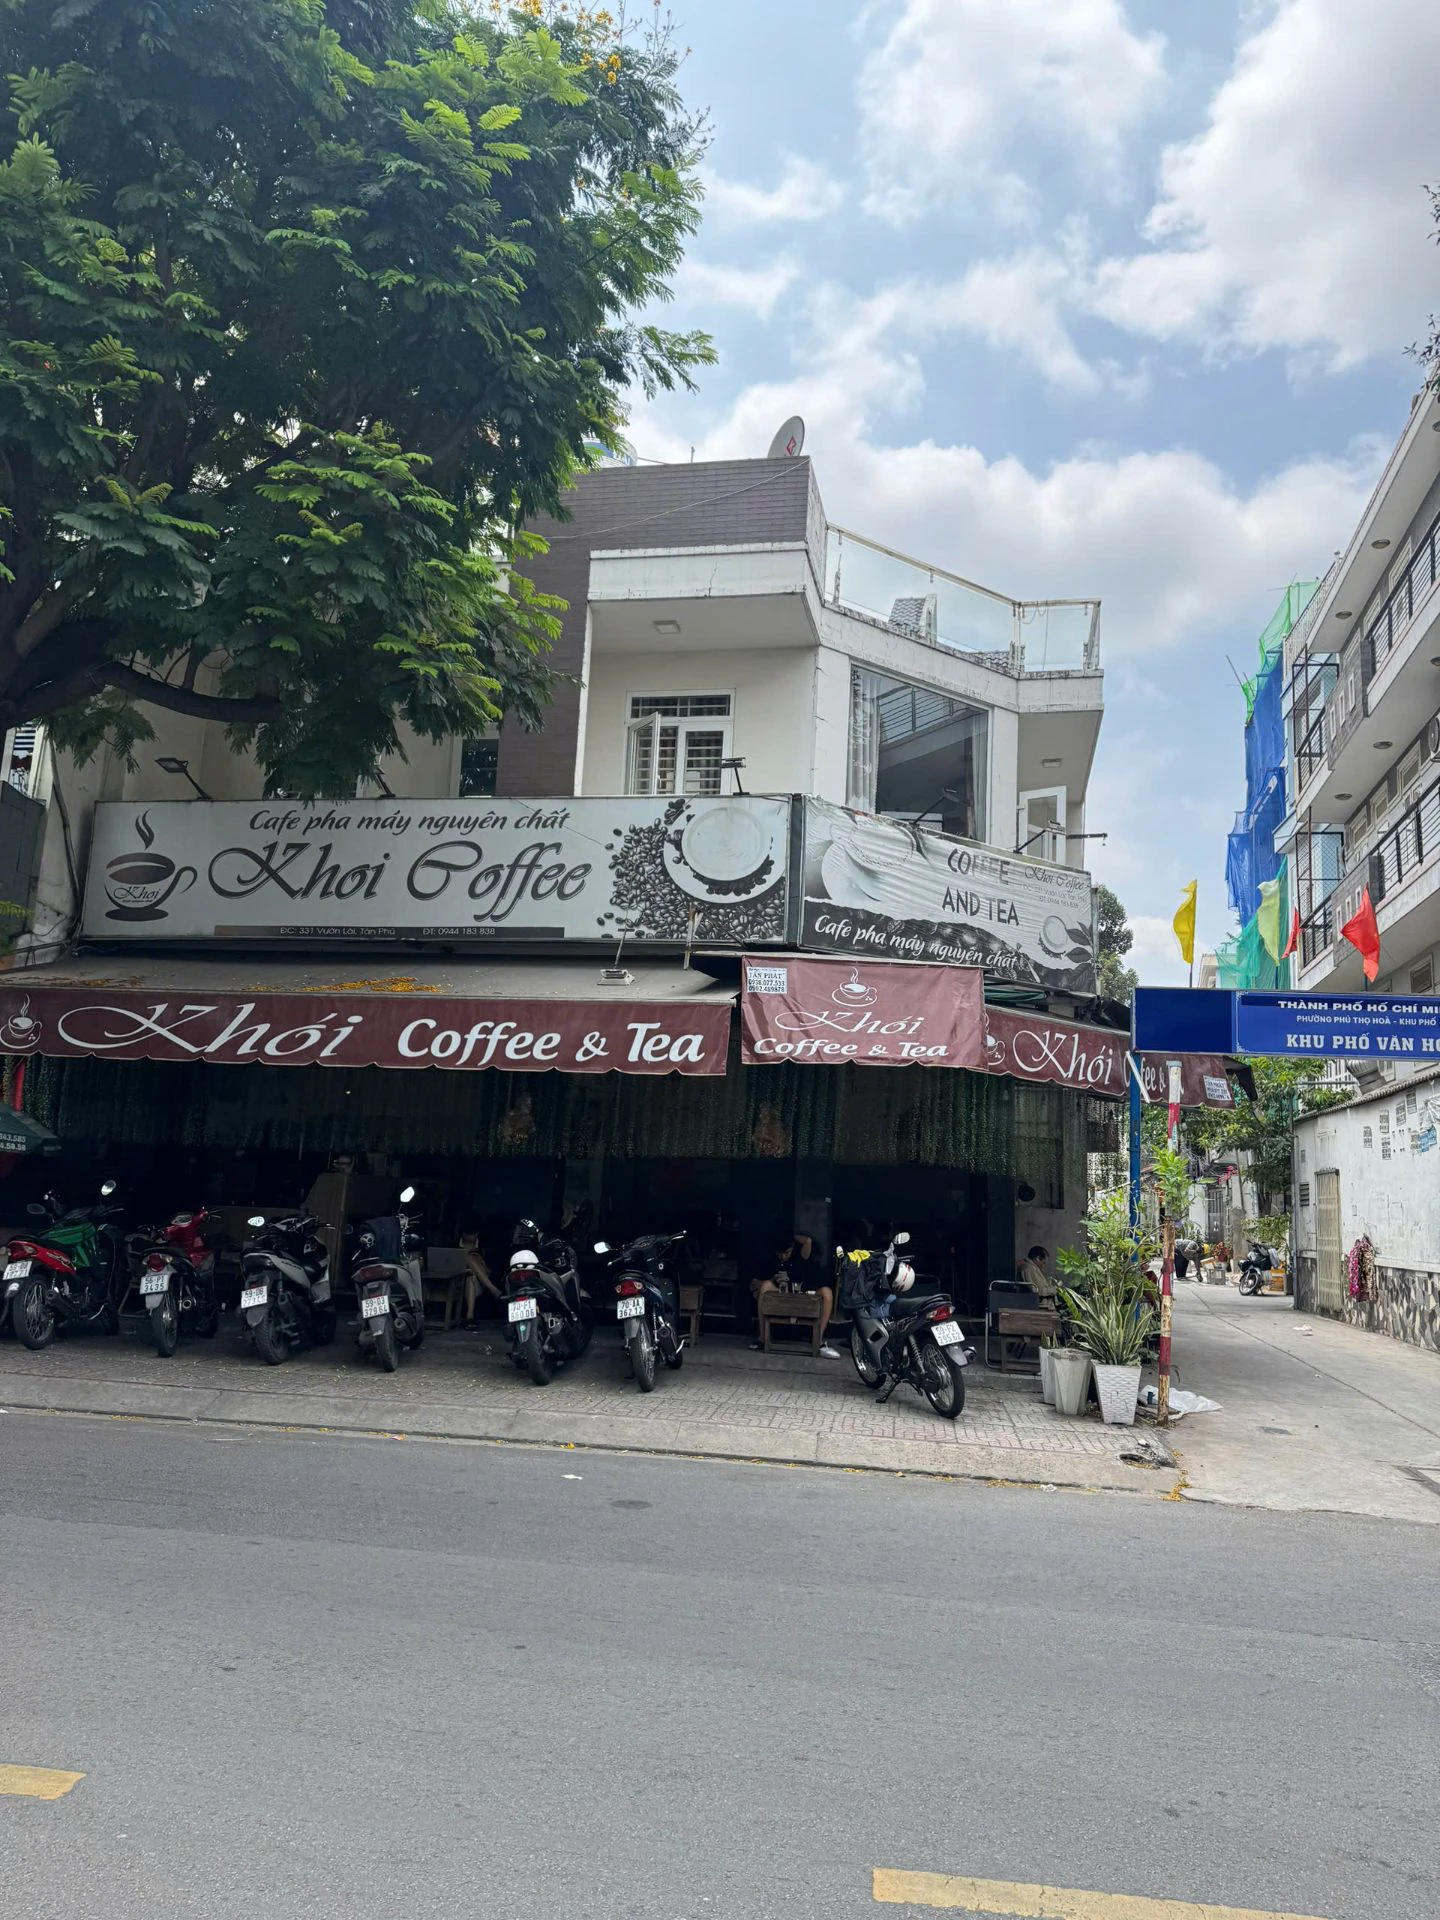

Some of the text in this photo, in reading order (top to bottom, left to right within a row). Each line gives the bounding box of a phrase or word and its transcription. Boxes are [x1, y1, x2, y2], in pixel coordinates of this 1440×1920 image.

[250, 807, 570, 836] Cafe pha máy nguyên chất
[407, 840, 592, 922] Coffee
[942, 886, 1019, 926] AND TEA
[299, 927, 314, 936] 331
[438, 927, 459, 936] 0944
[462, 927, 477, 936] 183
[479, 927, 496, 936] 838
[814, 915, 1018, 969] Cafe pha máy nguyên chất
[1278, 999, 1328, 1011] THÀNH
[1332, 1000, 1364, 1012] PHỐ
[1391, 1003, 1418, 1013] CHÍ
[1421, 1005, 1440, 1014] MI
[774, 1010, 925, 1034] Khói
[1296, 1013, 1332, 1023] PHƯỜNG
[1353, 1016, 1370, 1026] THỌ
[1372, 1015, 1391, 1025] HOÀ
[1399, 1017, 1417, 1025] KHU
[1419, 1015, 1437, 1026] PHỐ
[58, 1002, 705, 1066] Khói Coffee & Tea
[1286, 1034, 1325, 1049] KHU
[1332, 1032, 1370, 1049] PHỐ
[1376, 1034, 1414, 1051] VĂN
[754, 1037, 949, 1058] Coffee & Tea
[1013, 1030, 1113, 1085] Khói
[1159, 1067, 1166, 1093] &
[145, 1283, 164, 1292] 3435
